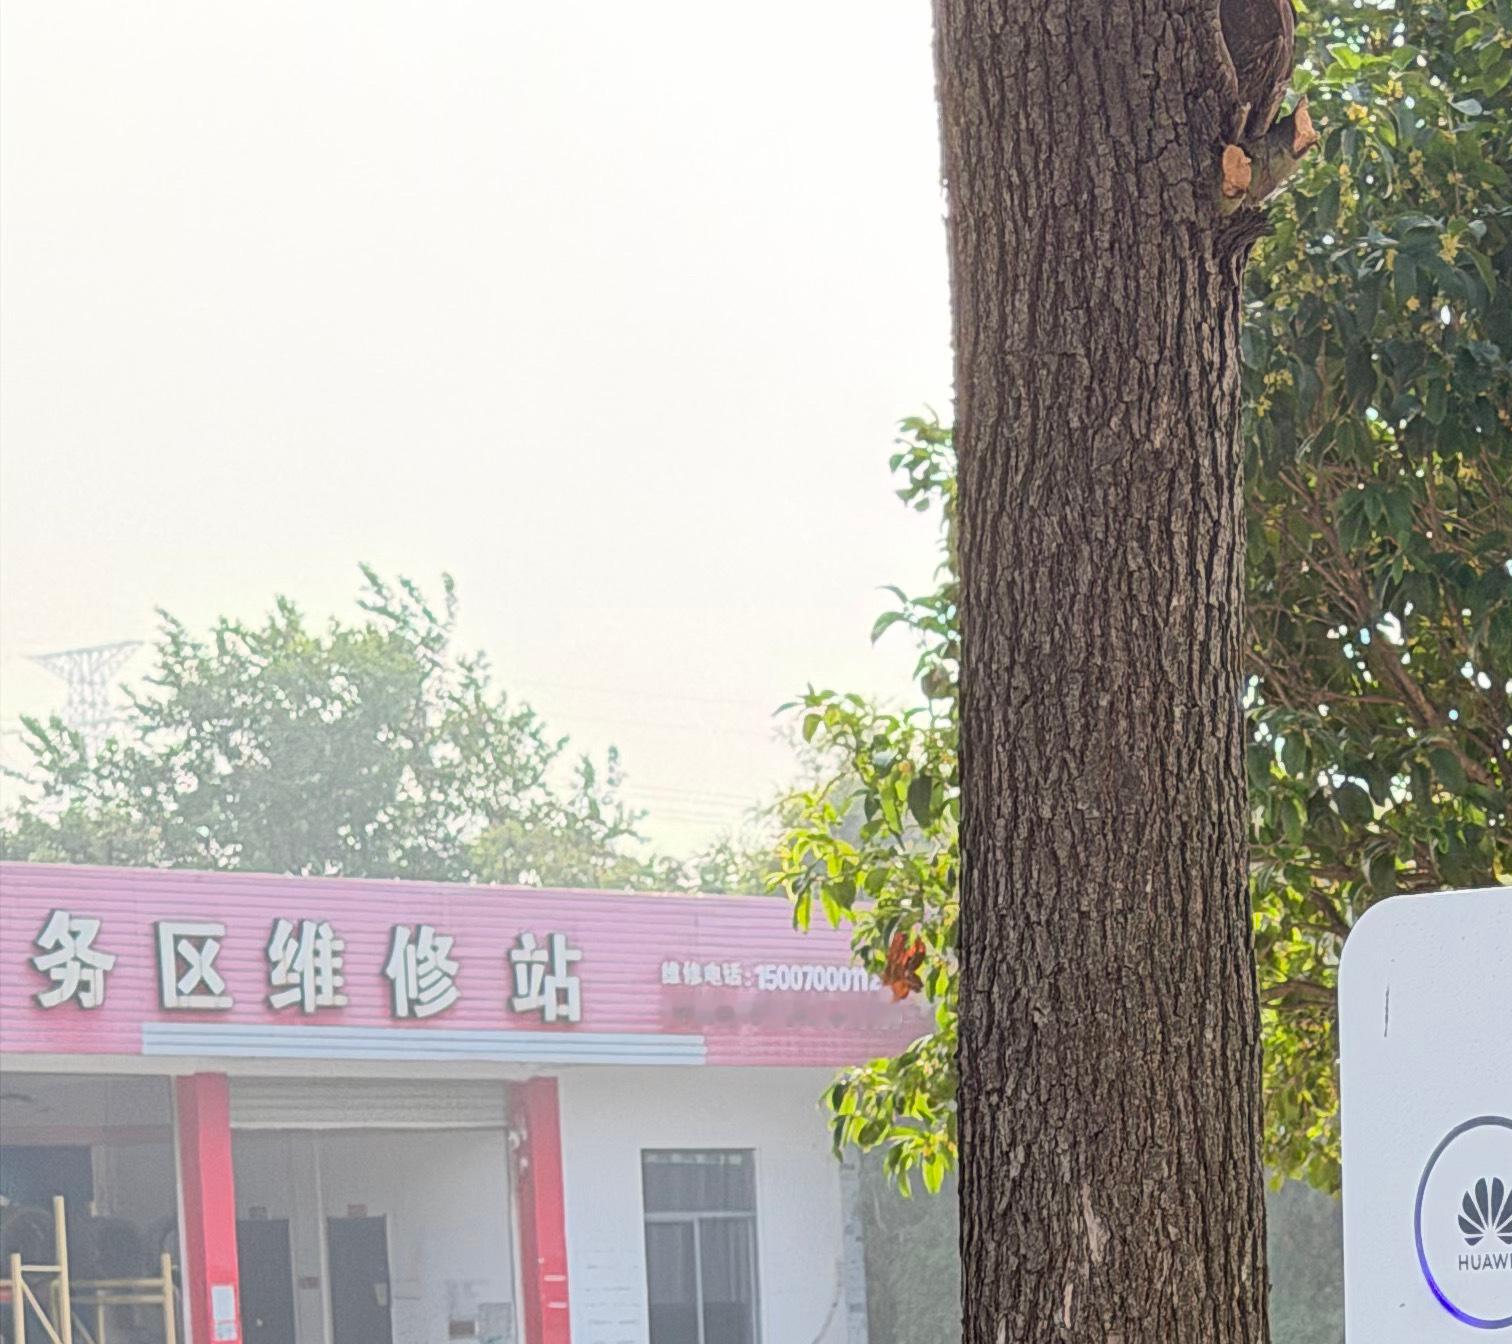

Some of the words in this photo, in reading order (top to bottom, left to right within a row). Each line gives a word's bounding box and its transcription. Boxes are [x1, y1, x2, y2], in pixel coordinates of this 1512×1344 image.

[31, 908, 584, 1024] 务区维修站
